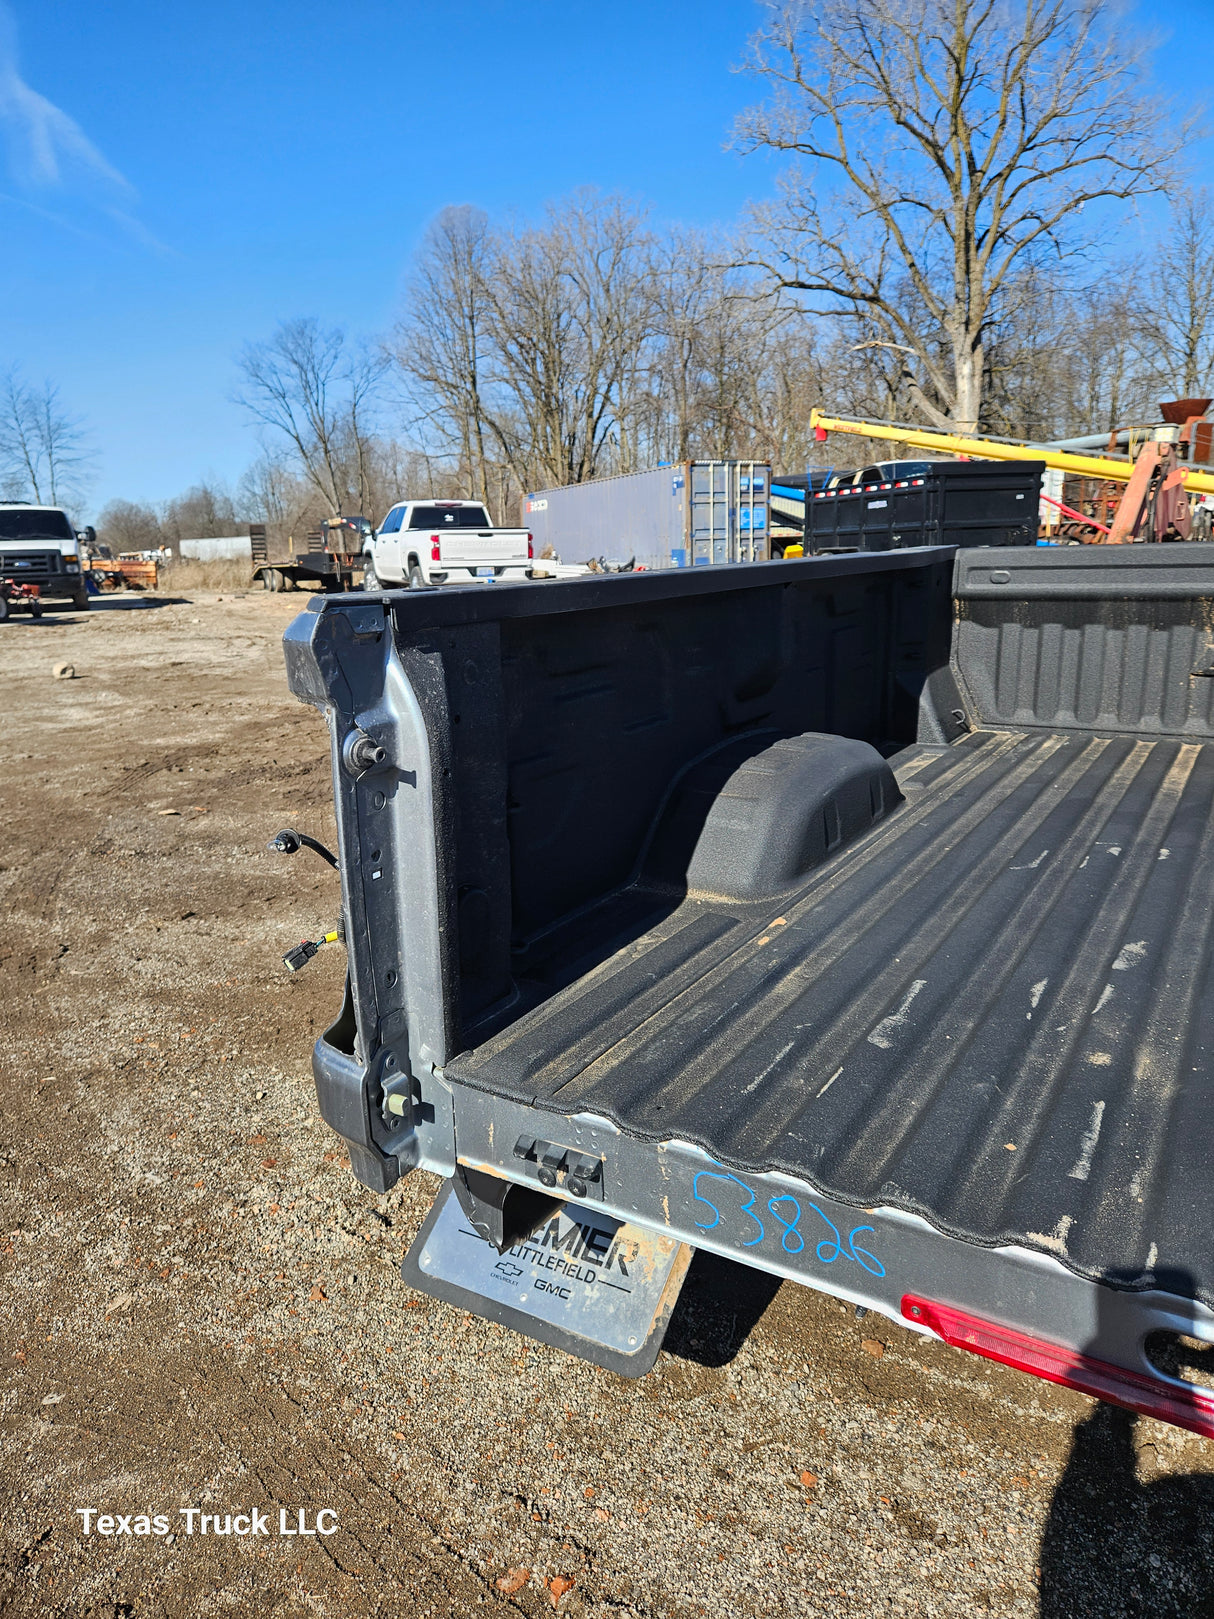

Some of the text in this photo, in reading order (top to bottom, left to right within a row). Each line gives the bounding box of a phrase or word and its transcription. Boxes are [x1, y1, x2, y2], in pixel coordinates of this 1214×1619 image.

[693, 1170, 886, 1278] 53826
[509, 1244, 597, 1285] LITTLEFIELD
[533, 1278, 572, 1300] GMC
